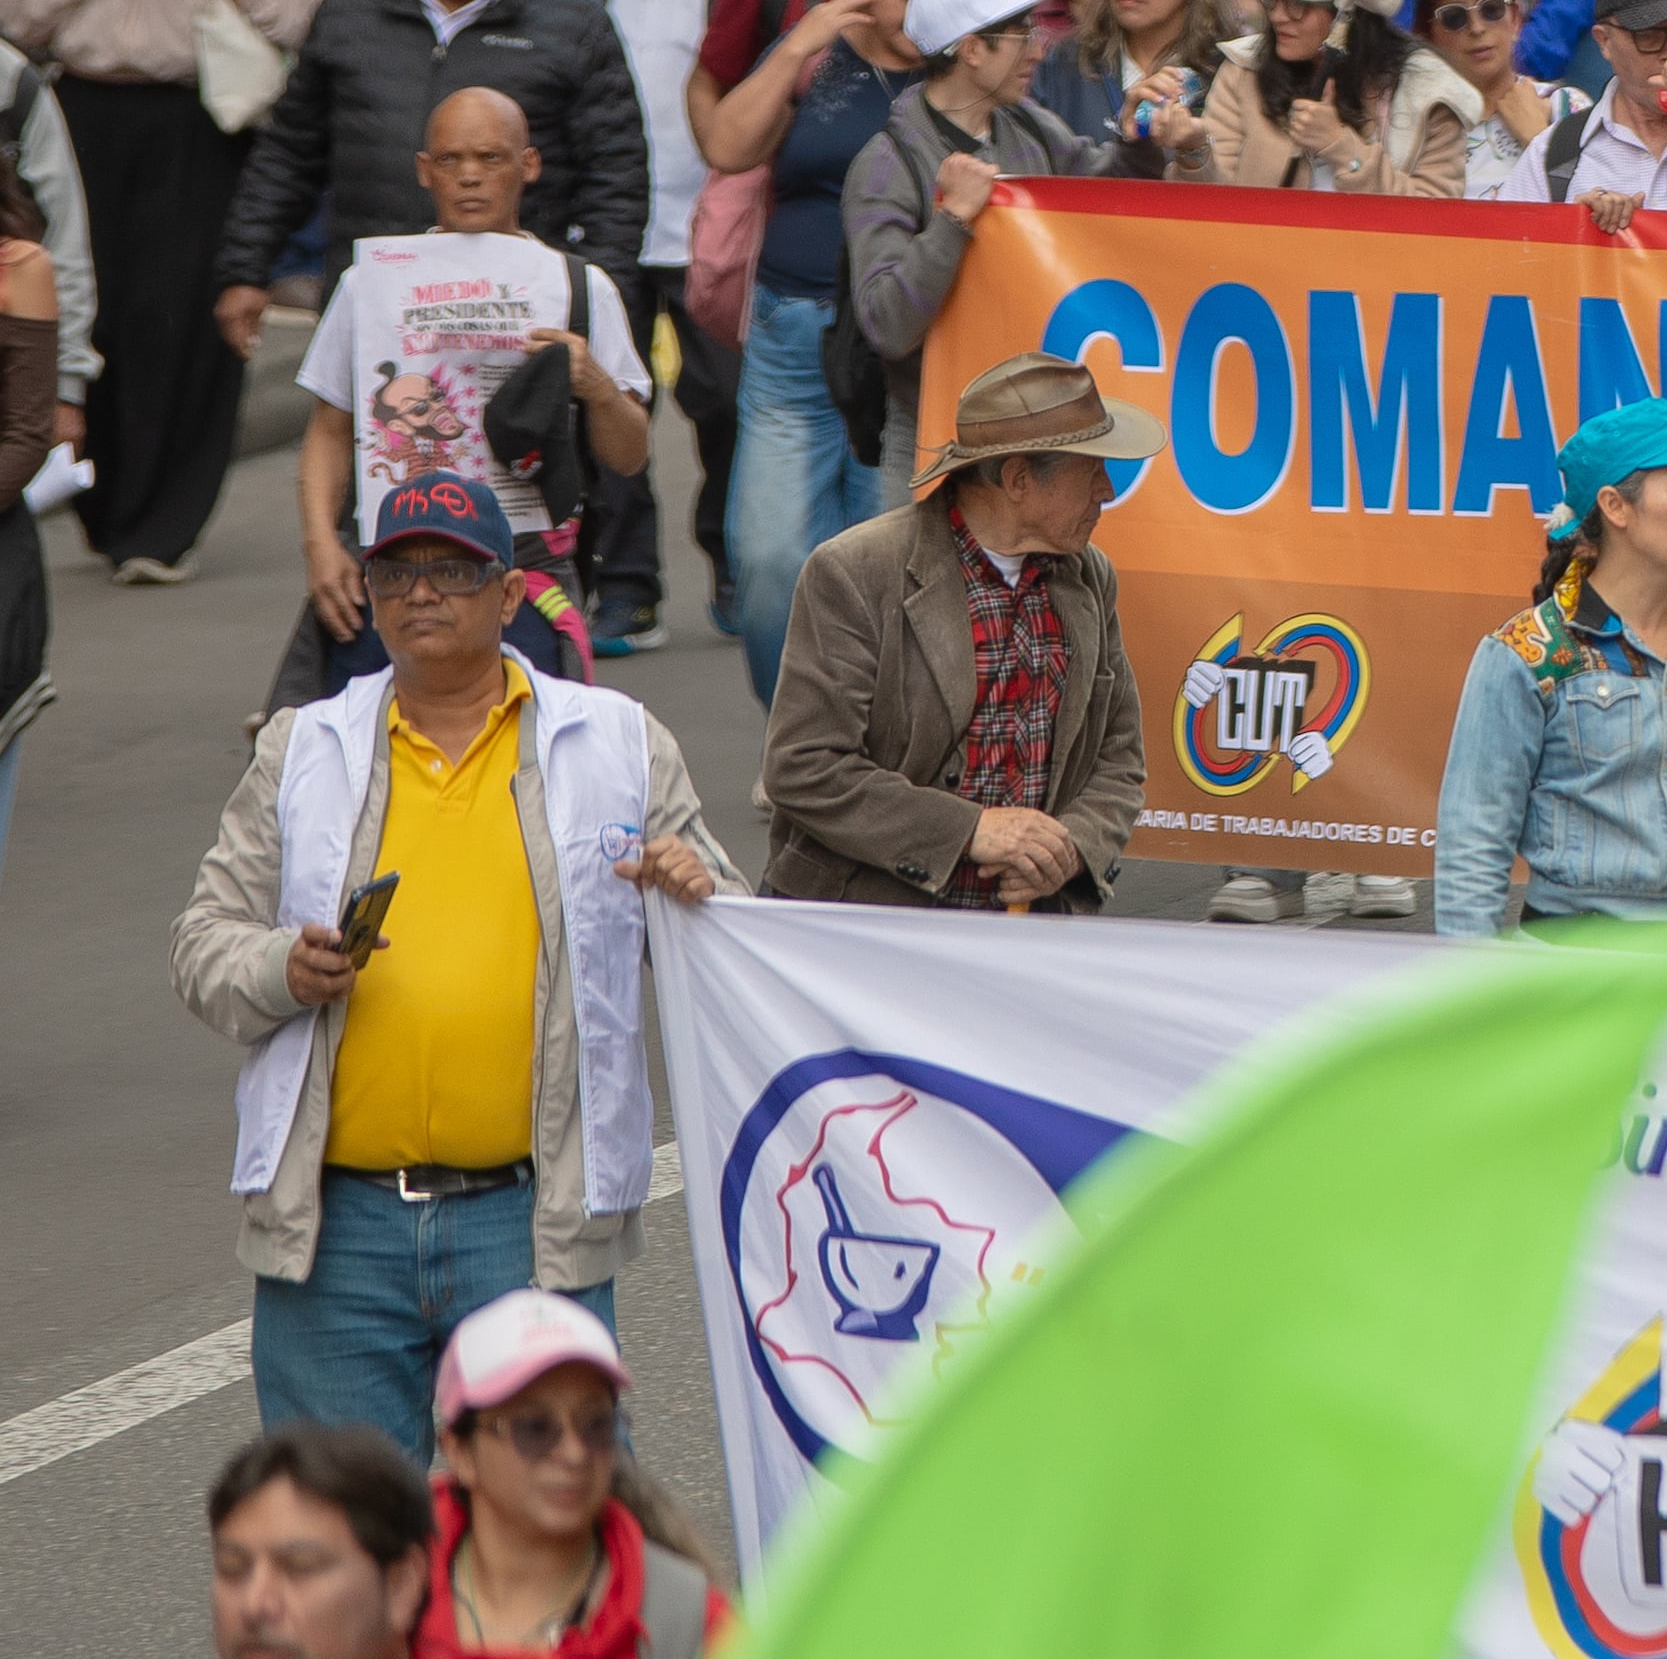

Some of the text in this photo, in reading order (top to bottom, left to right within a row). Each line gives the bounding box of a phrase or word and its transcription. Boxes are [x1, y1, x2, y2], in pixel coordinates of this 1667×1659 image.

[413, 278, 491, 304] MIEDO
[403, 300, 534, 324] PRESIDENTE
[1217, 668, 1308, 754] CUT
[1136, 809, 1188, 831] ARIA
[1190, 812, 1219, 833] DE
[1221, 815, 1382, 844] TRABAJADORES
[1386, 827, 1417, 847] DE
